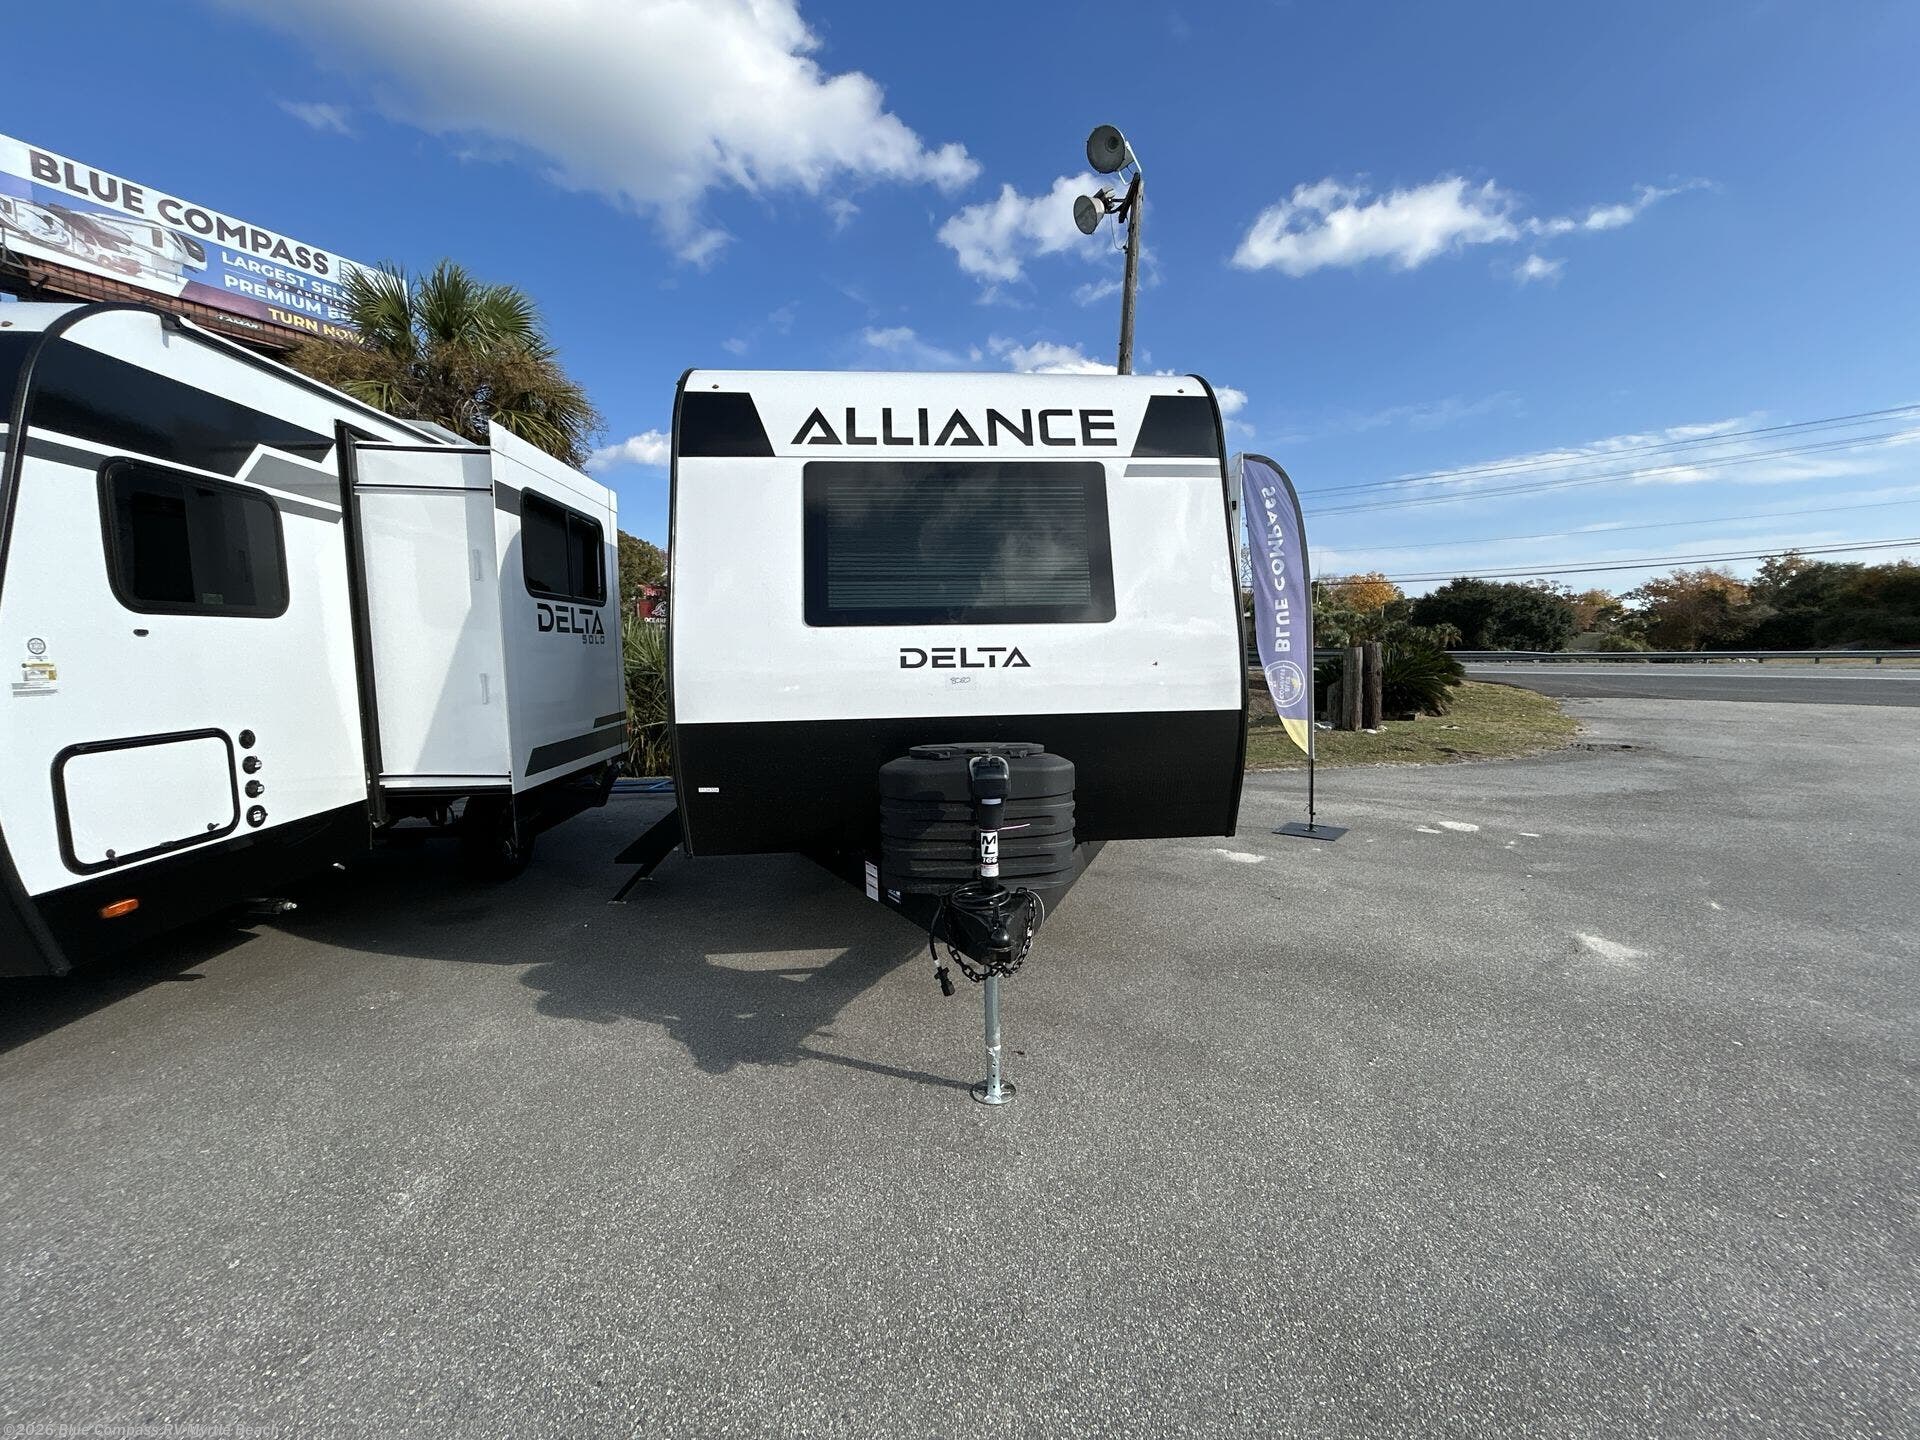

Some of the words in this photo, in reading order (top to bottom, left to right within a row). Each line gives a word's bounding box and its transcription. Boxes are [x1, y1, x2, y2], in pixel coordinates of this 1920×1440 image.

[29, 149, 144, 214] BLUE
[157, 199, 329, 275] COMPASS
[221, 251, 307, 288] LARGEST
[224, 274, 321, 315] PREMIUM
[268, 307, 318, 334] TURN
[790, 406, 1118, 447] ALLIANCE
[536, 602, 605, 635] DELTA
[582, 634, 605, 645] SOLO
[900, 646, 1031, 668] DELTA
